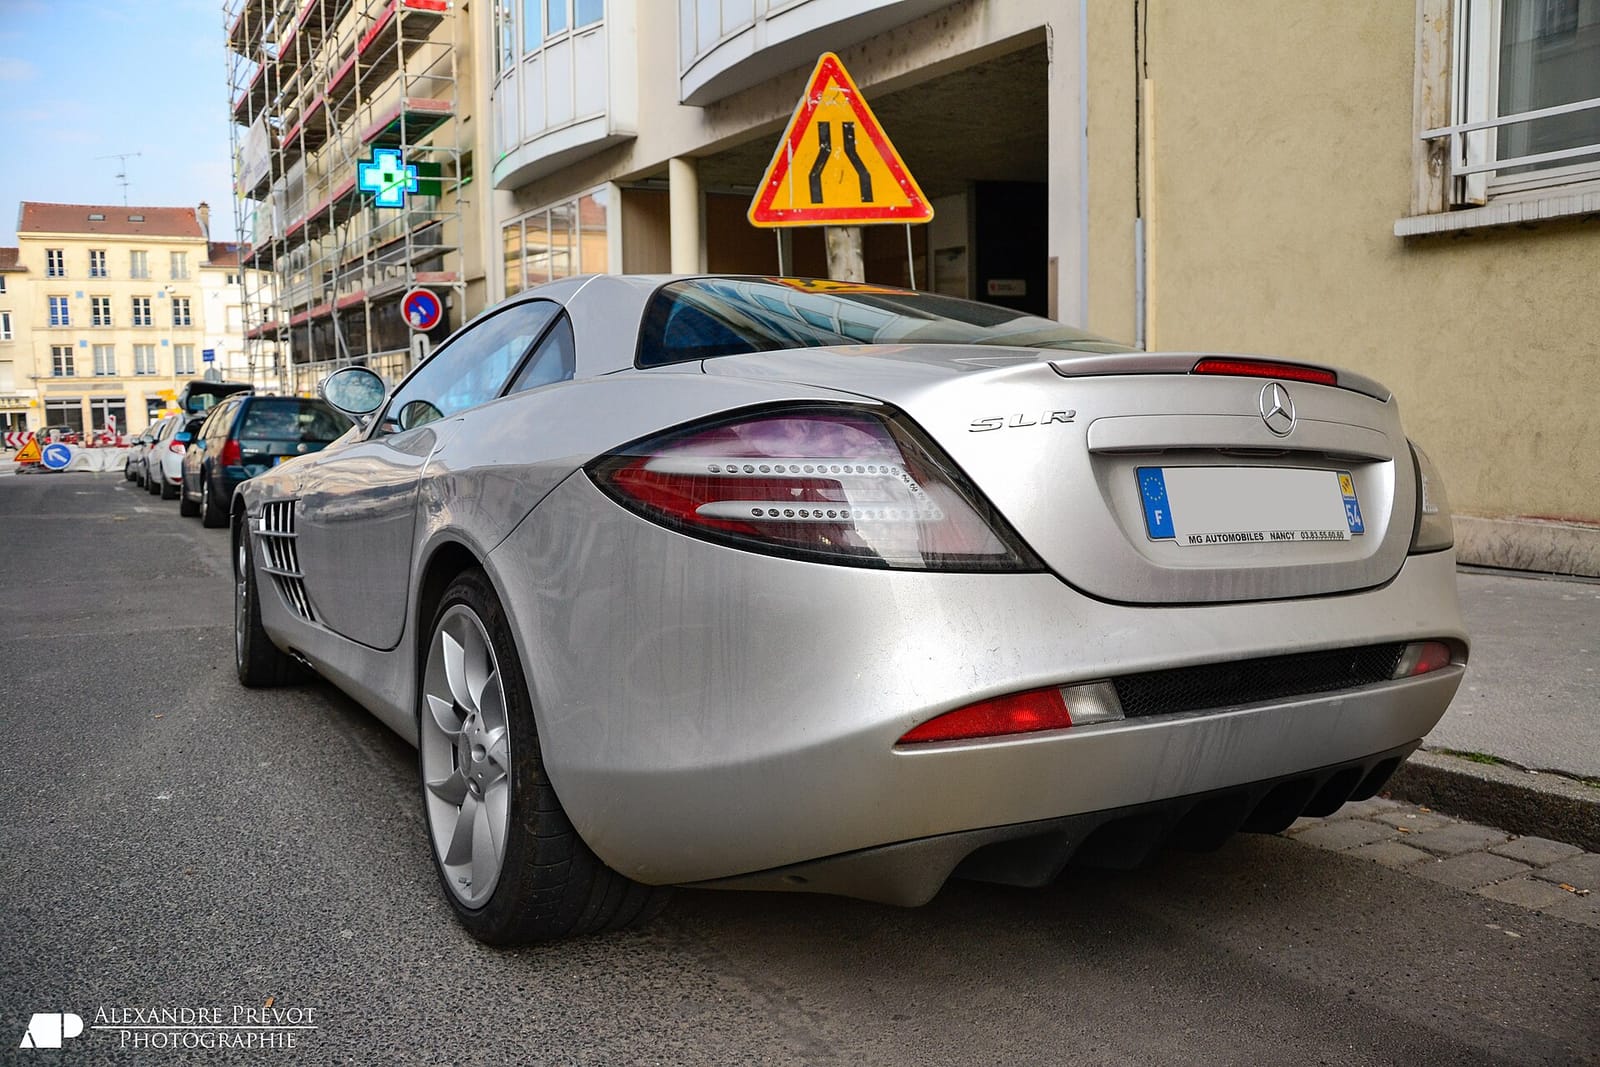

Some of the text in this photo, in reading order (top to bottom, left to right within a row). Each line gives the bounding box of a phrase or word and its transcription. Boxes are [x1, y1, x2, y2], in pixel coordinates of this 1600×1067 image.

[968, 409, 1076, 432] SLR
[1154, 509, 1163, 525] F
[1345, 503, 1361, 526] 54
[1188, 535, 1203, 544] MG
[1205, 532, 1264, 544] AUTOMOBILES
[1270, 531, 1295, 540] NANCY
